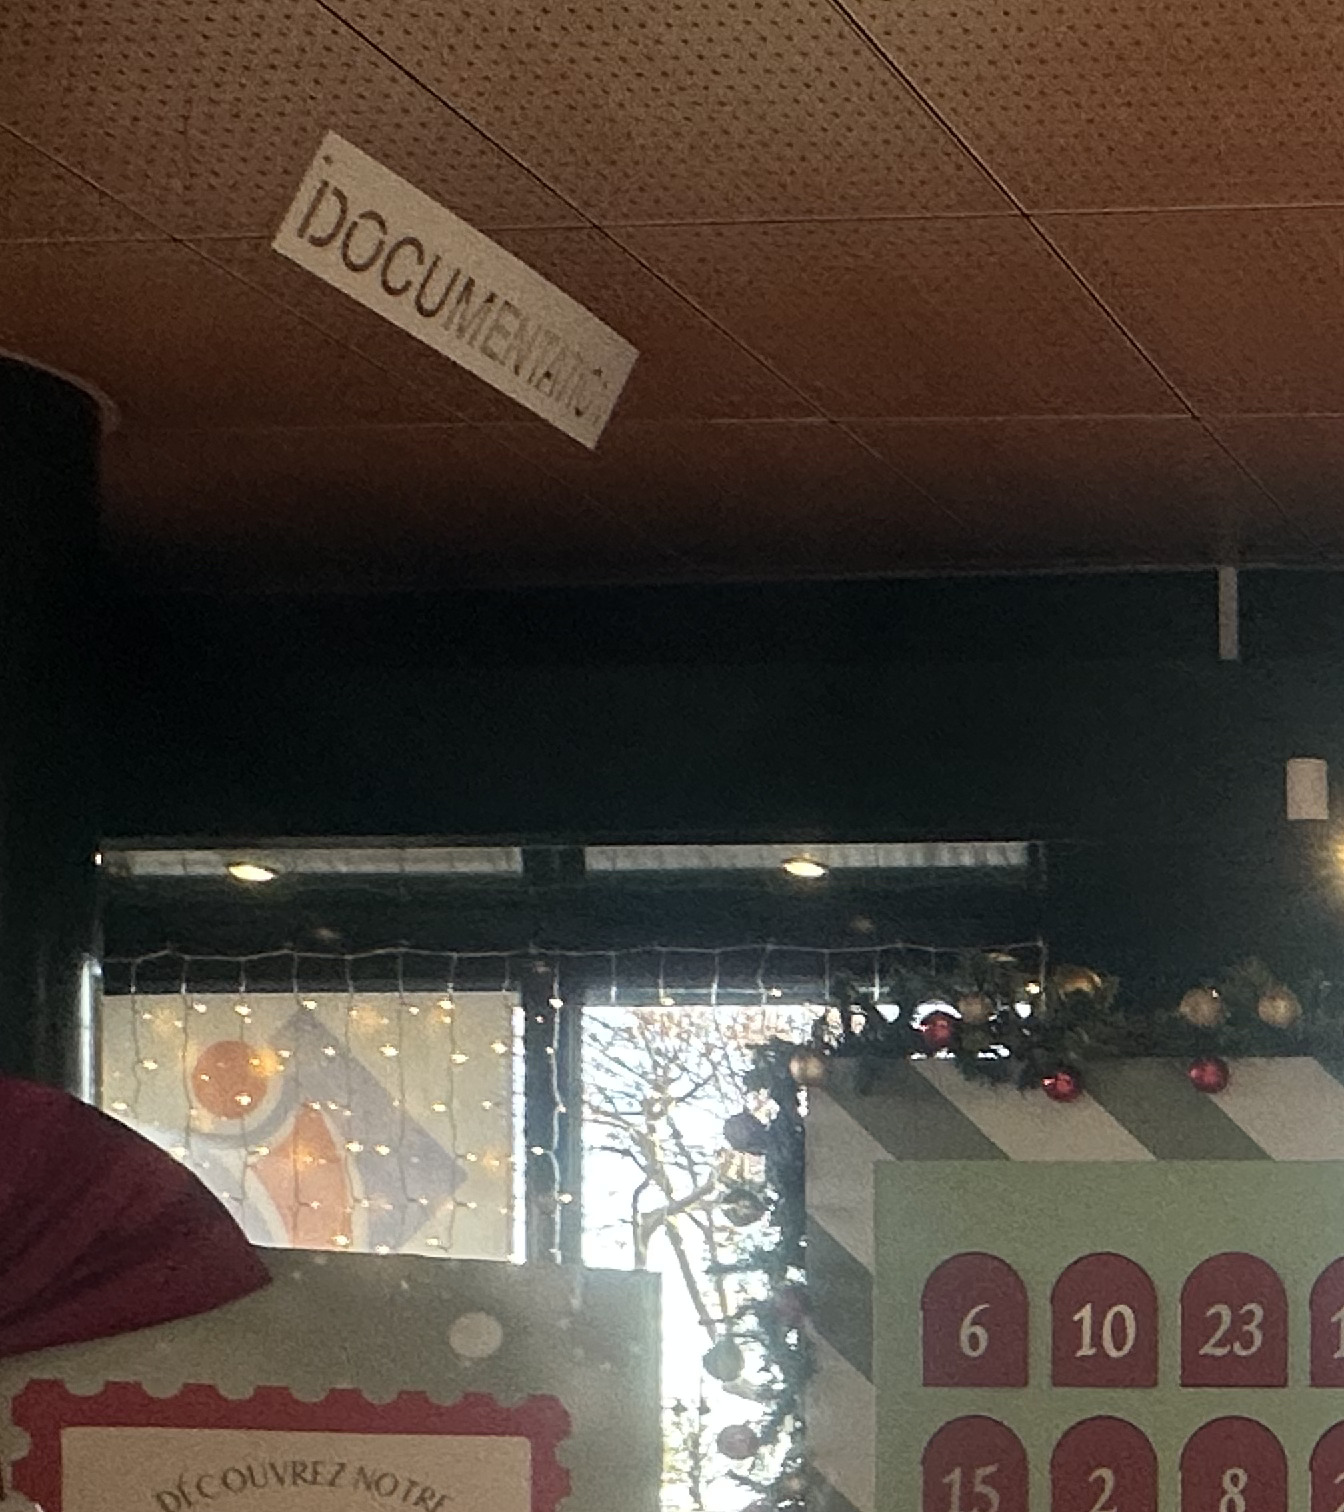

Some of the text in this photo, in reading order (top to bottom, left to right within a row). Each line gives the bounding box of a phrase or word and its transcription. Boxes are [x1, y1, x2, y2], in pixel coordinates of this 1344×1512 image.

[960, 1304, 988, 1357] 6
[1073, 1304, 1135, 1358] 10
[1200, 1303, 1263, 1356] 23
